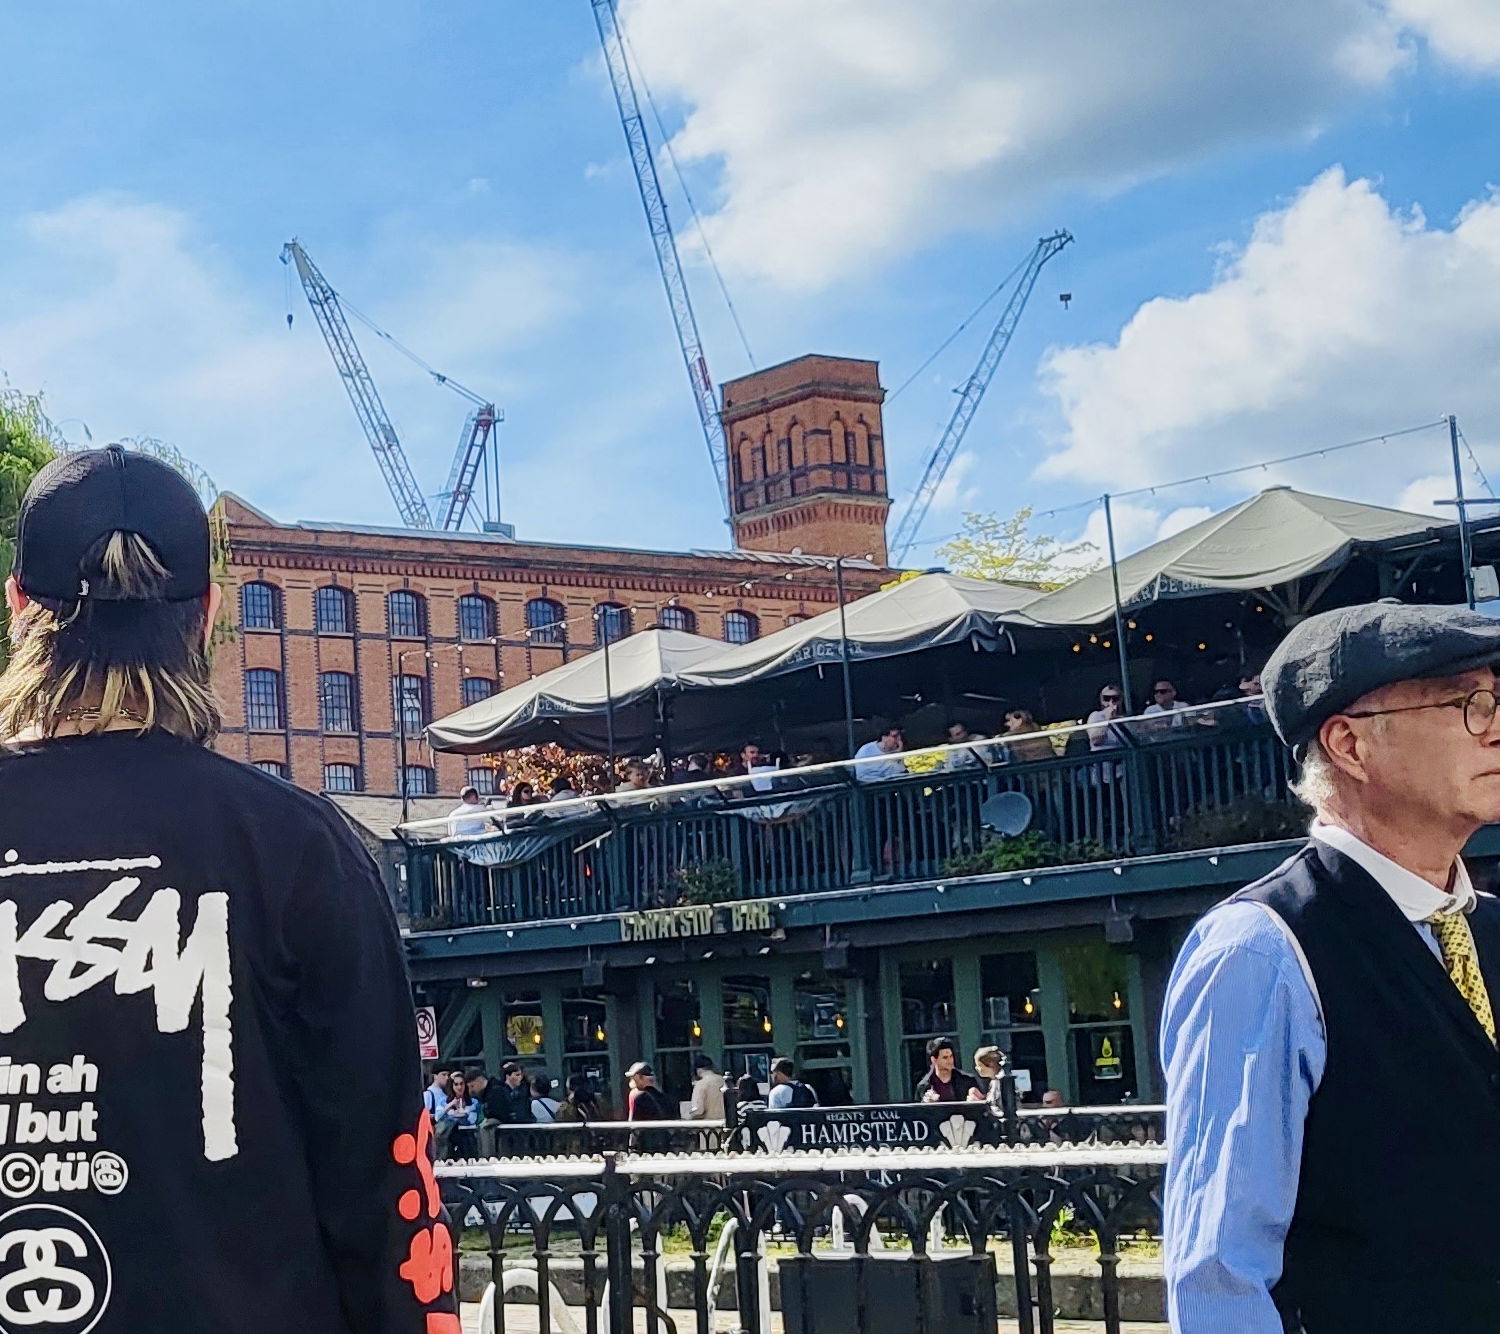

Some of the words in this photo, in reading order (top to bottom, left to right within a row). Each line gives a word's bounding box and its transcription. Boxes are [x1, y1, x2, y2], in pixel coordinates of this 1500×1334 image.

[731, 901, 771, 933] BAR
[46, 1054, 99, 1094] ah
[15, 1101, 99, 1144] but
[870, 1109, 901, 1120] CANAL
[801, 1120, 929, 1145] HAMPSTEAD
